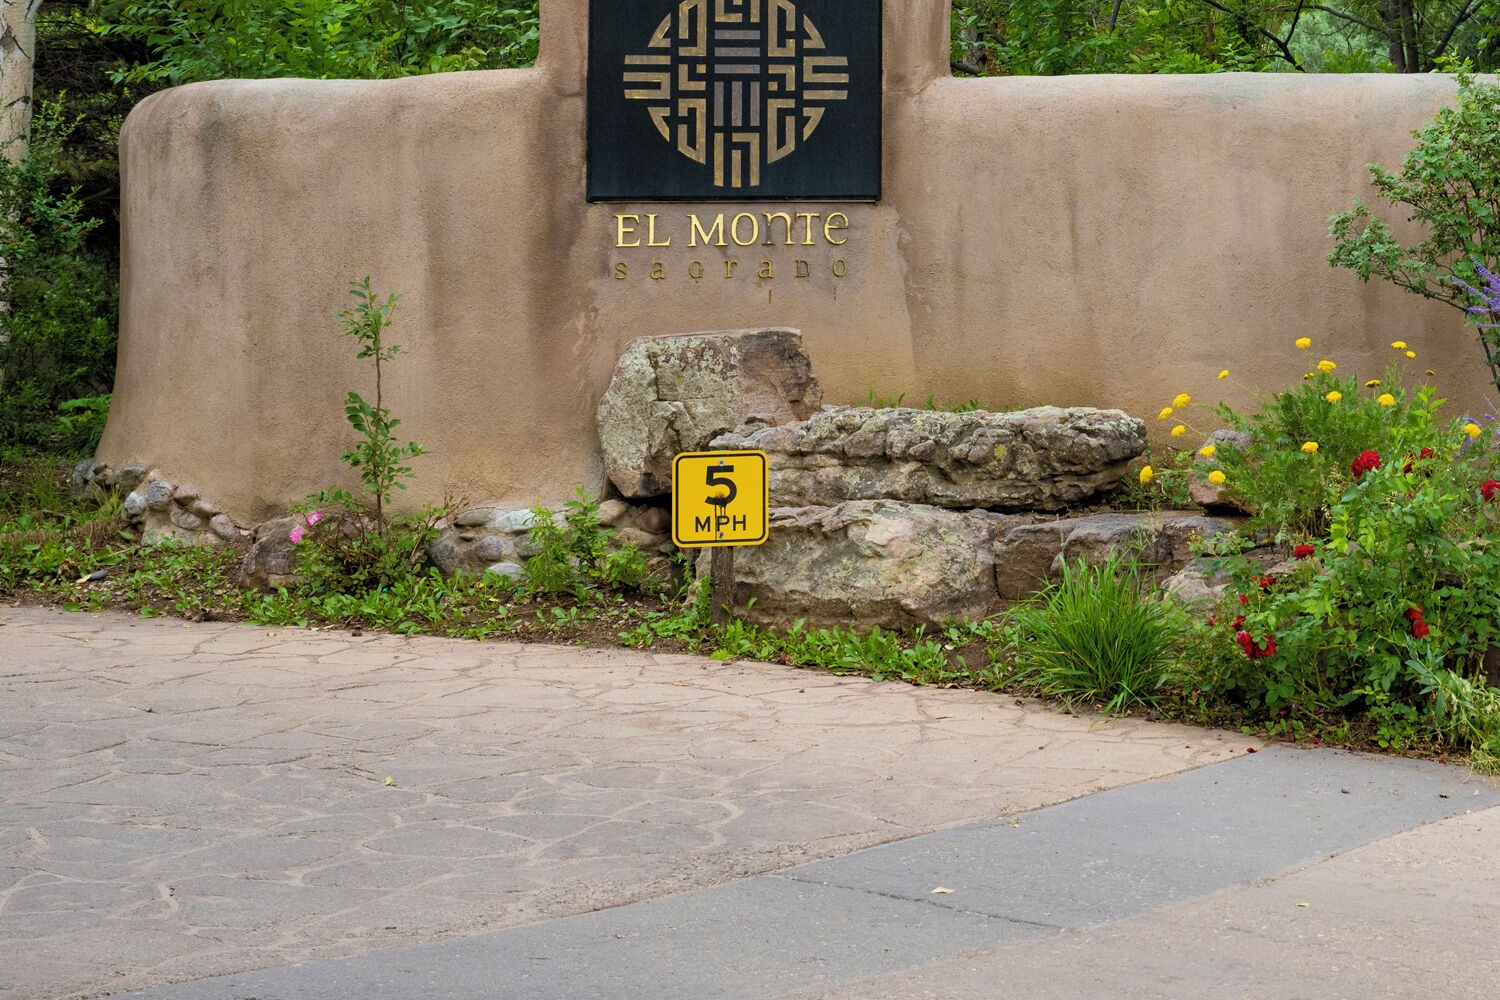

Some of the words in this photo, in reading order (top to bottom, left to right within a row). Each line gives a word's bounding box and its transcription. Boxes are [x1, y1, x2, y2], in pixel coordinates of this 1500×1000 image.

[614, 213, 671, 248] EL
[704, 465, 737, 506] 5
[695, 514, 746, 533] MPH
